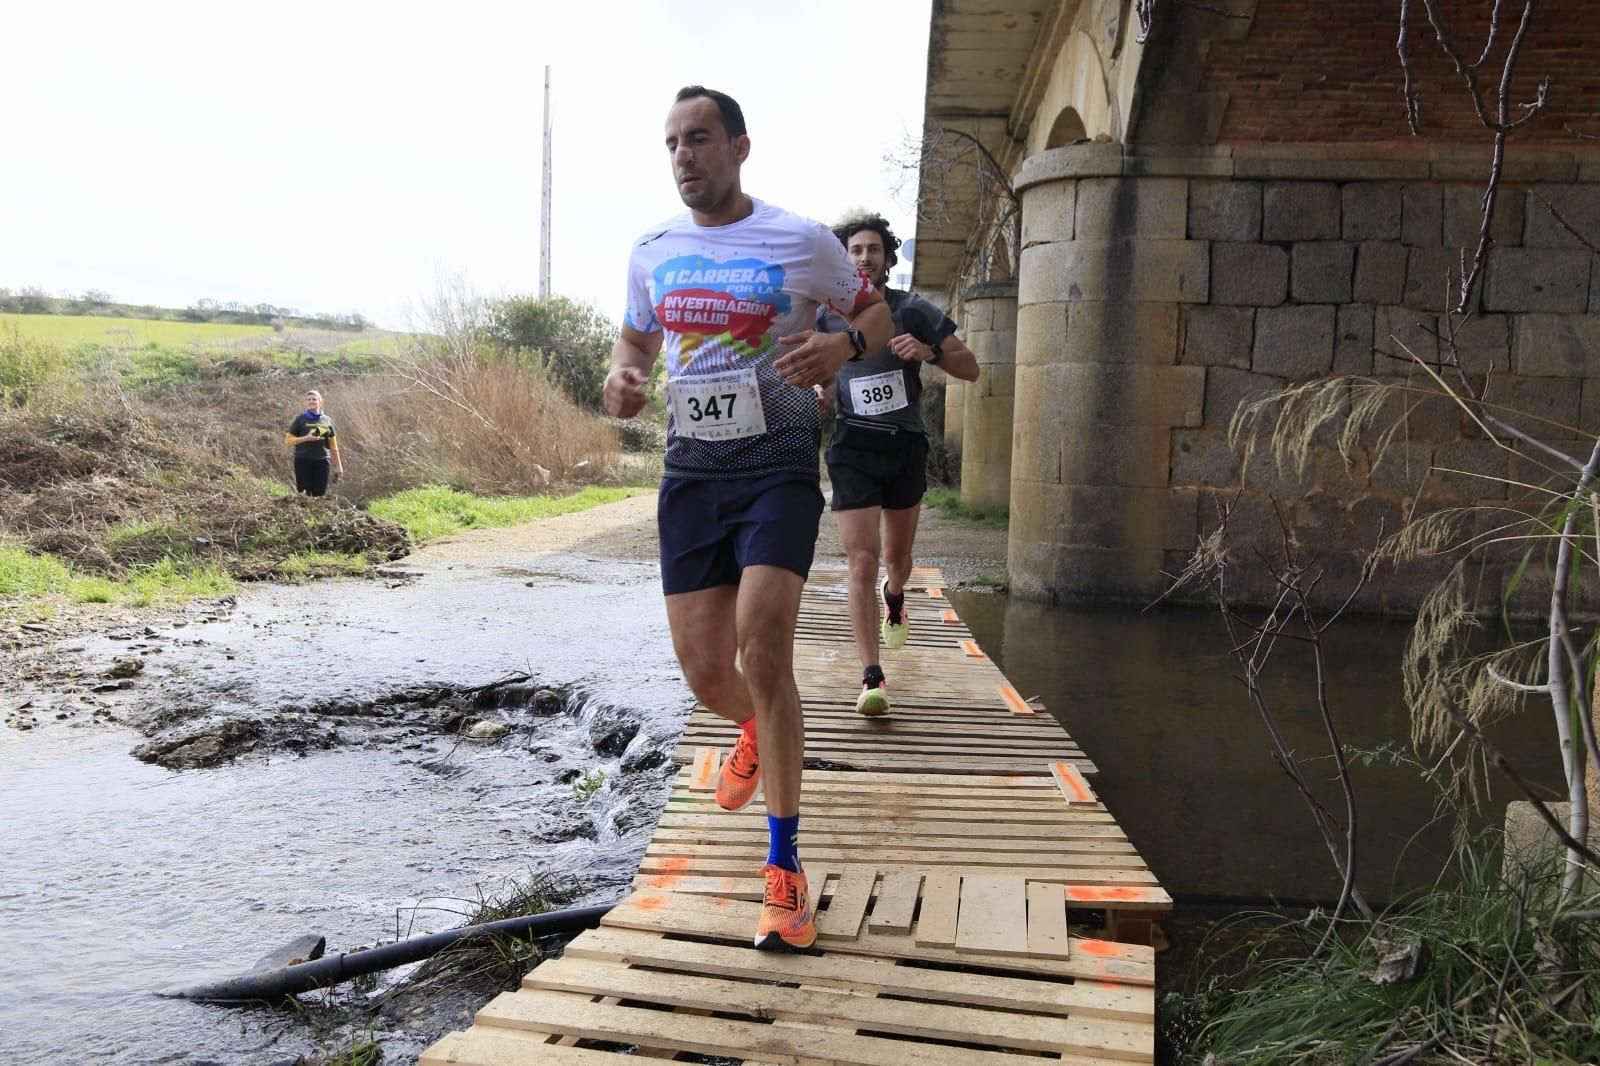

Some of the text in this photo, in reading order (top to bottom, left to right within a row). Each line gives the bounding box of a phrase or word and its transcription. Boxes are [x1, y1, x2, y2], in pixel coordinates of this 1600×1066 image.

[677, 268, 770, 284] CARRERA
[726, 284, 774, 294] POR LA
[664, 310, 729, 325] EN SALUD
[862, 384, 893, 404] 389
[688, 393, 737, 422] 347
